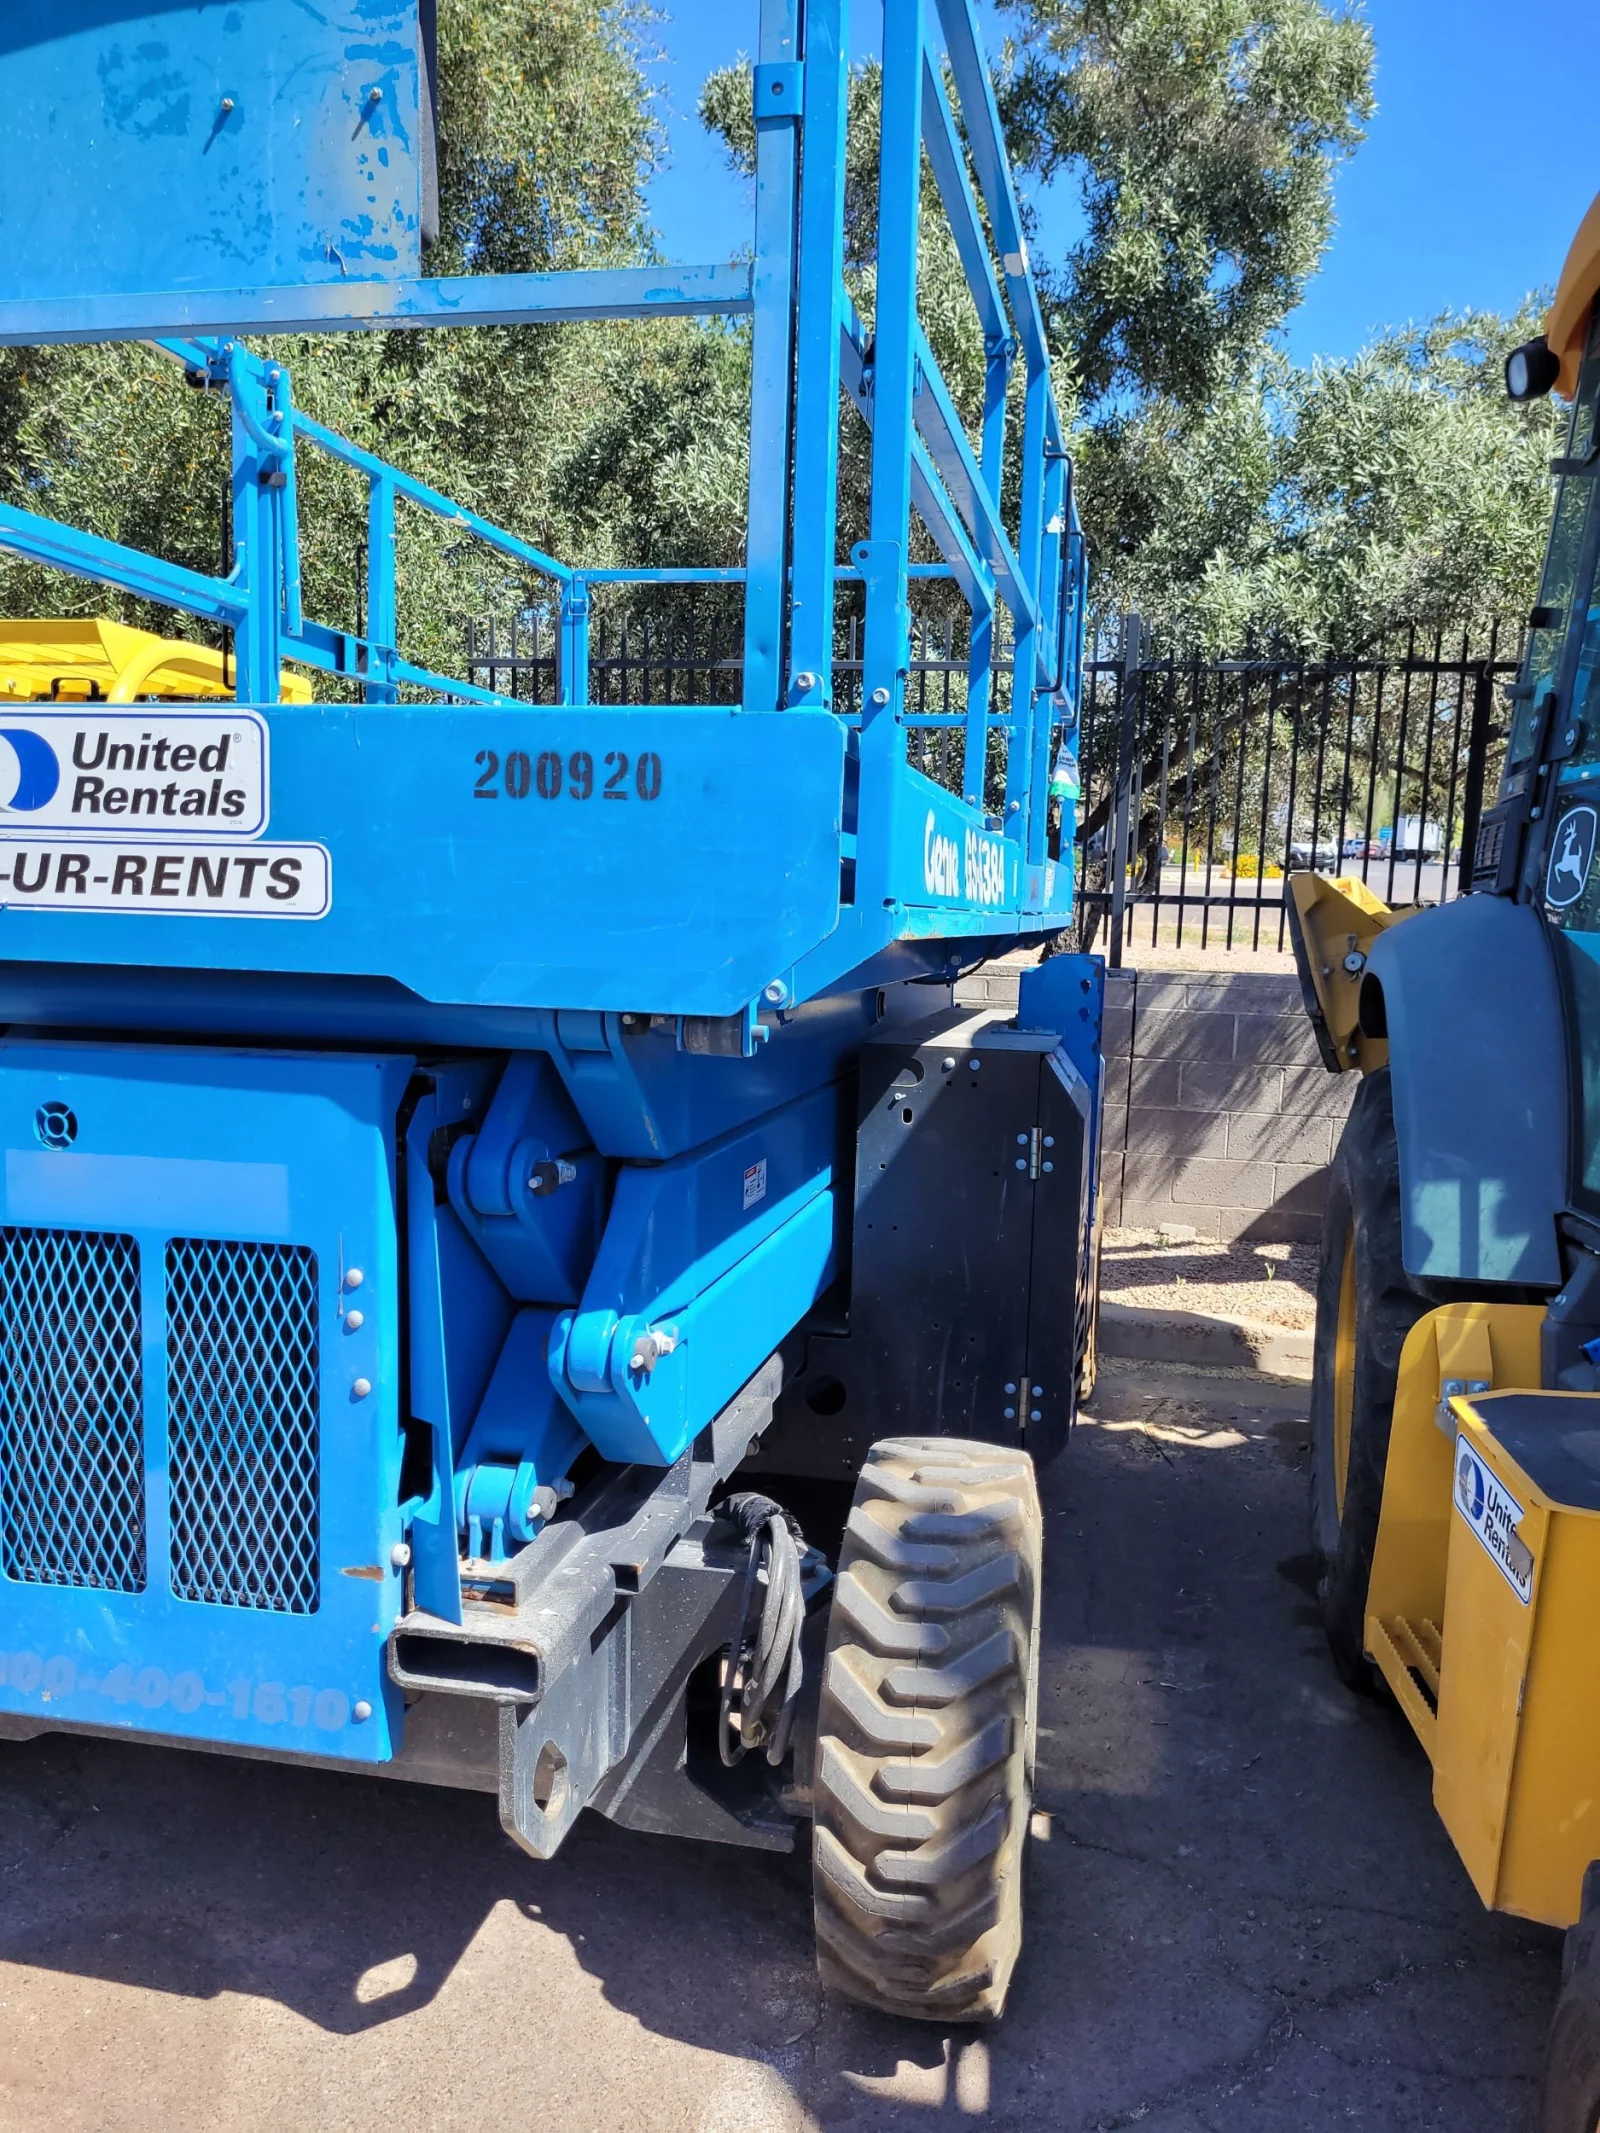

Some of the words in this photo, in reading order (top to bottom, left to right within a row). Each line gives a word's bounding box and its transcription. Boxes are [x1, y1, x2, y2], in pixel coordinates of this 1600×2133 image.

[72, 732, 231, 772] United
[474, 750, 662, 801] 200920
[71, 776, 247, 818] Rentals
[924, 808, 960, 898] Genie
[1487, 1484, 1517, 1536] Unite
[0, 1650, 349, 1732] 00-400-1610
